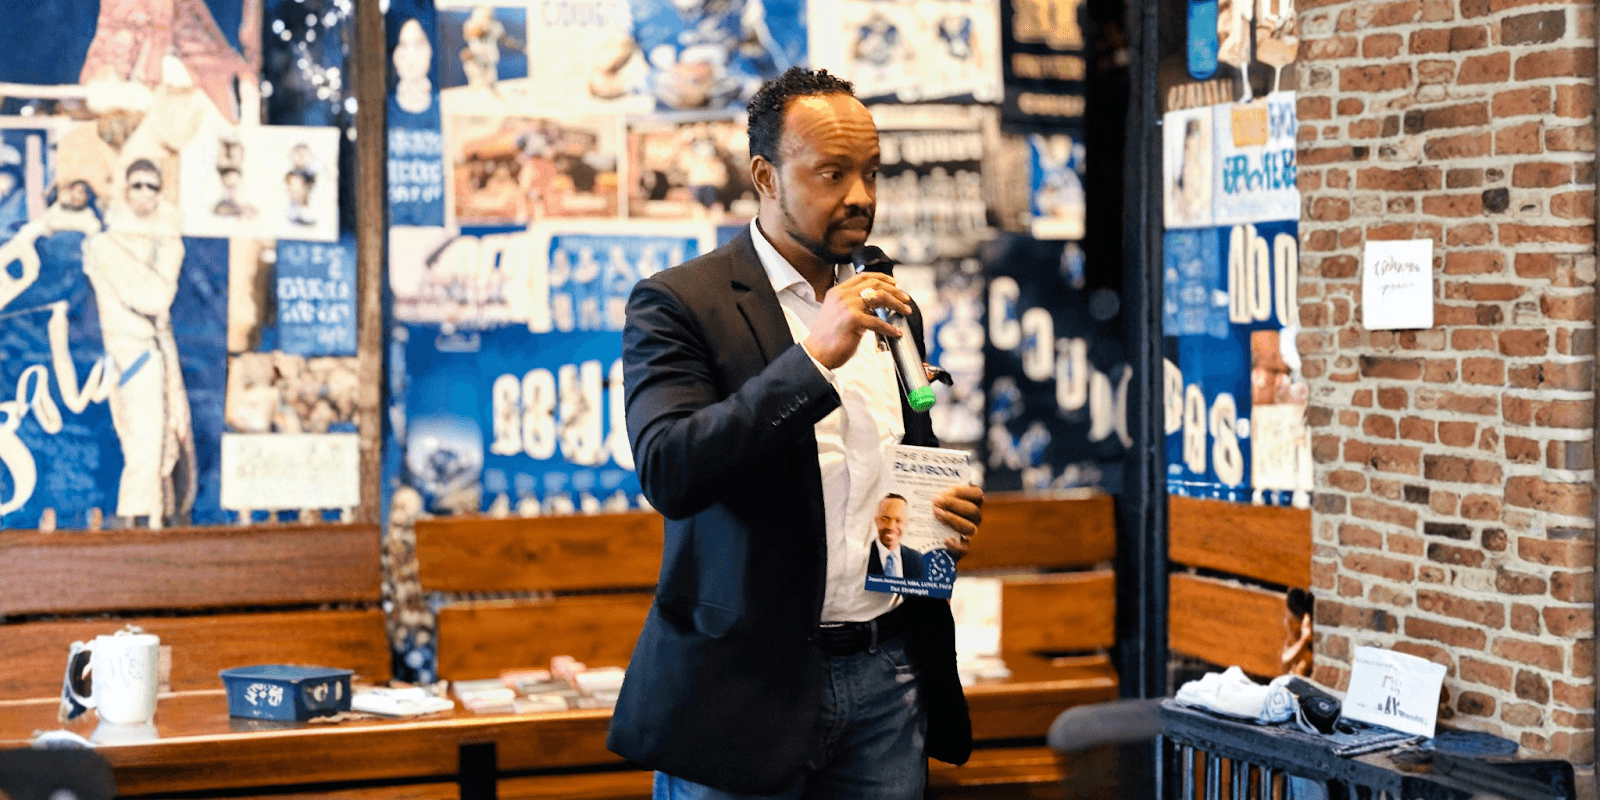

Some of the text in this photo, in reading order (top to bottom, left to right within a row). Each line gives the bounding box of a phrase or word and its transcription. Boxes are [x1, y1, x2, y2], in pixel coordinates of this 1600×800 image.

[895, 450, 918, 461] THE
[894, 461, 960, 477] PLAYBOOK
[901, 586, 929, 596] Strategist
